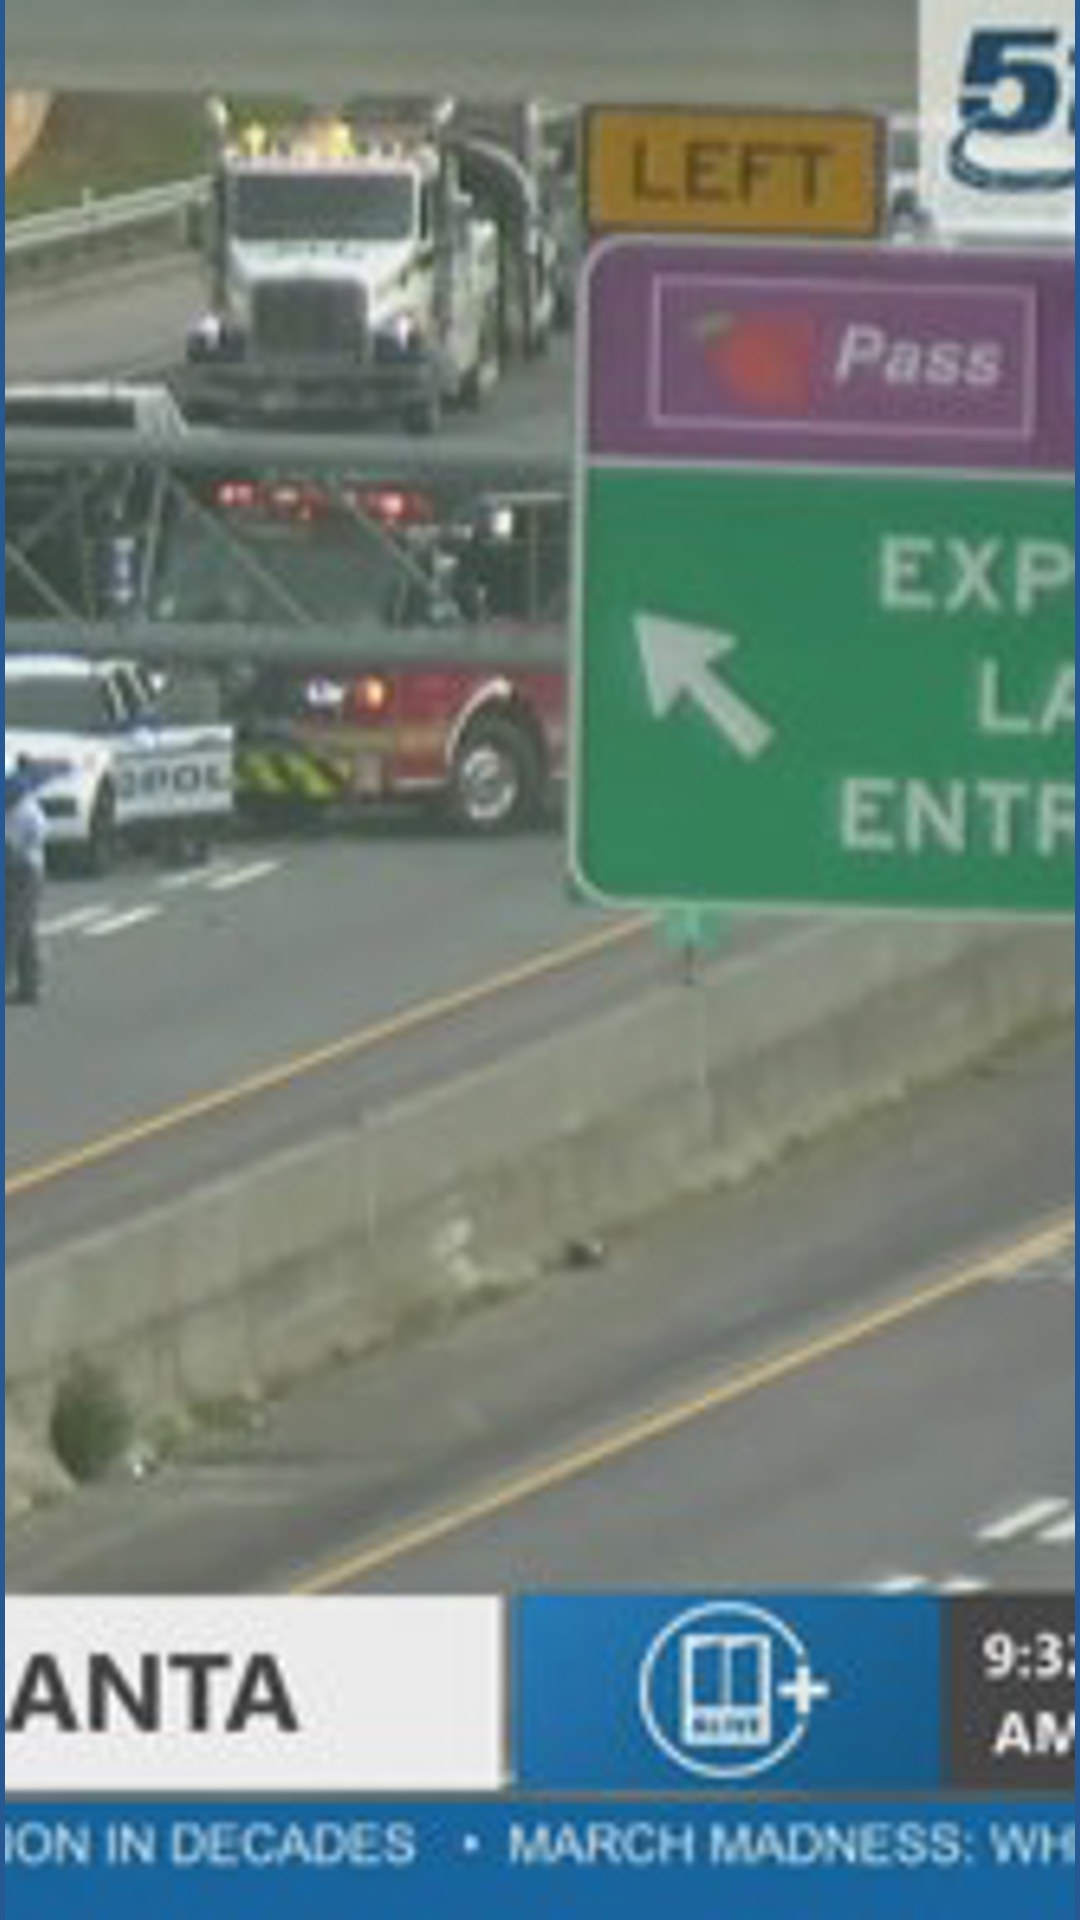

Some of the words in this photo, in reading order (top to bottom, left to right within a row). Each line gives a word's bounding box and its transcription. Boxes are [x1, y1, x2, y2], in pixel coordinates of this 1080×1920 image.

[632, 138, 833, 207] LEFT
[835, 324, 1004, 386] Pass
[880, 535, 1075, 614] EXP
